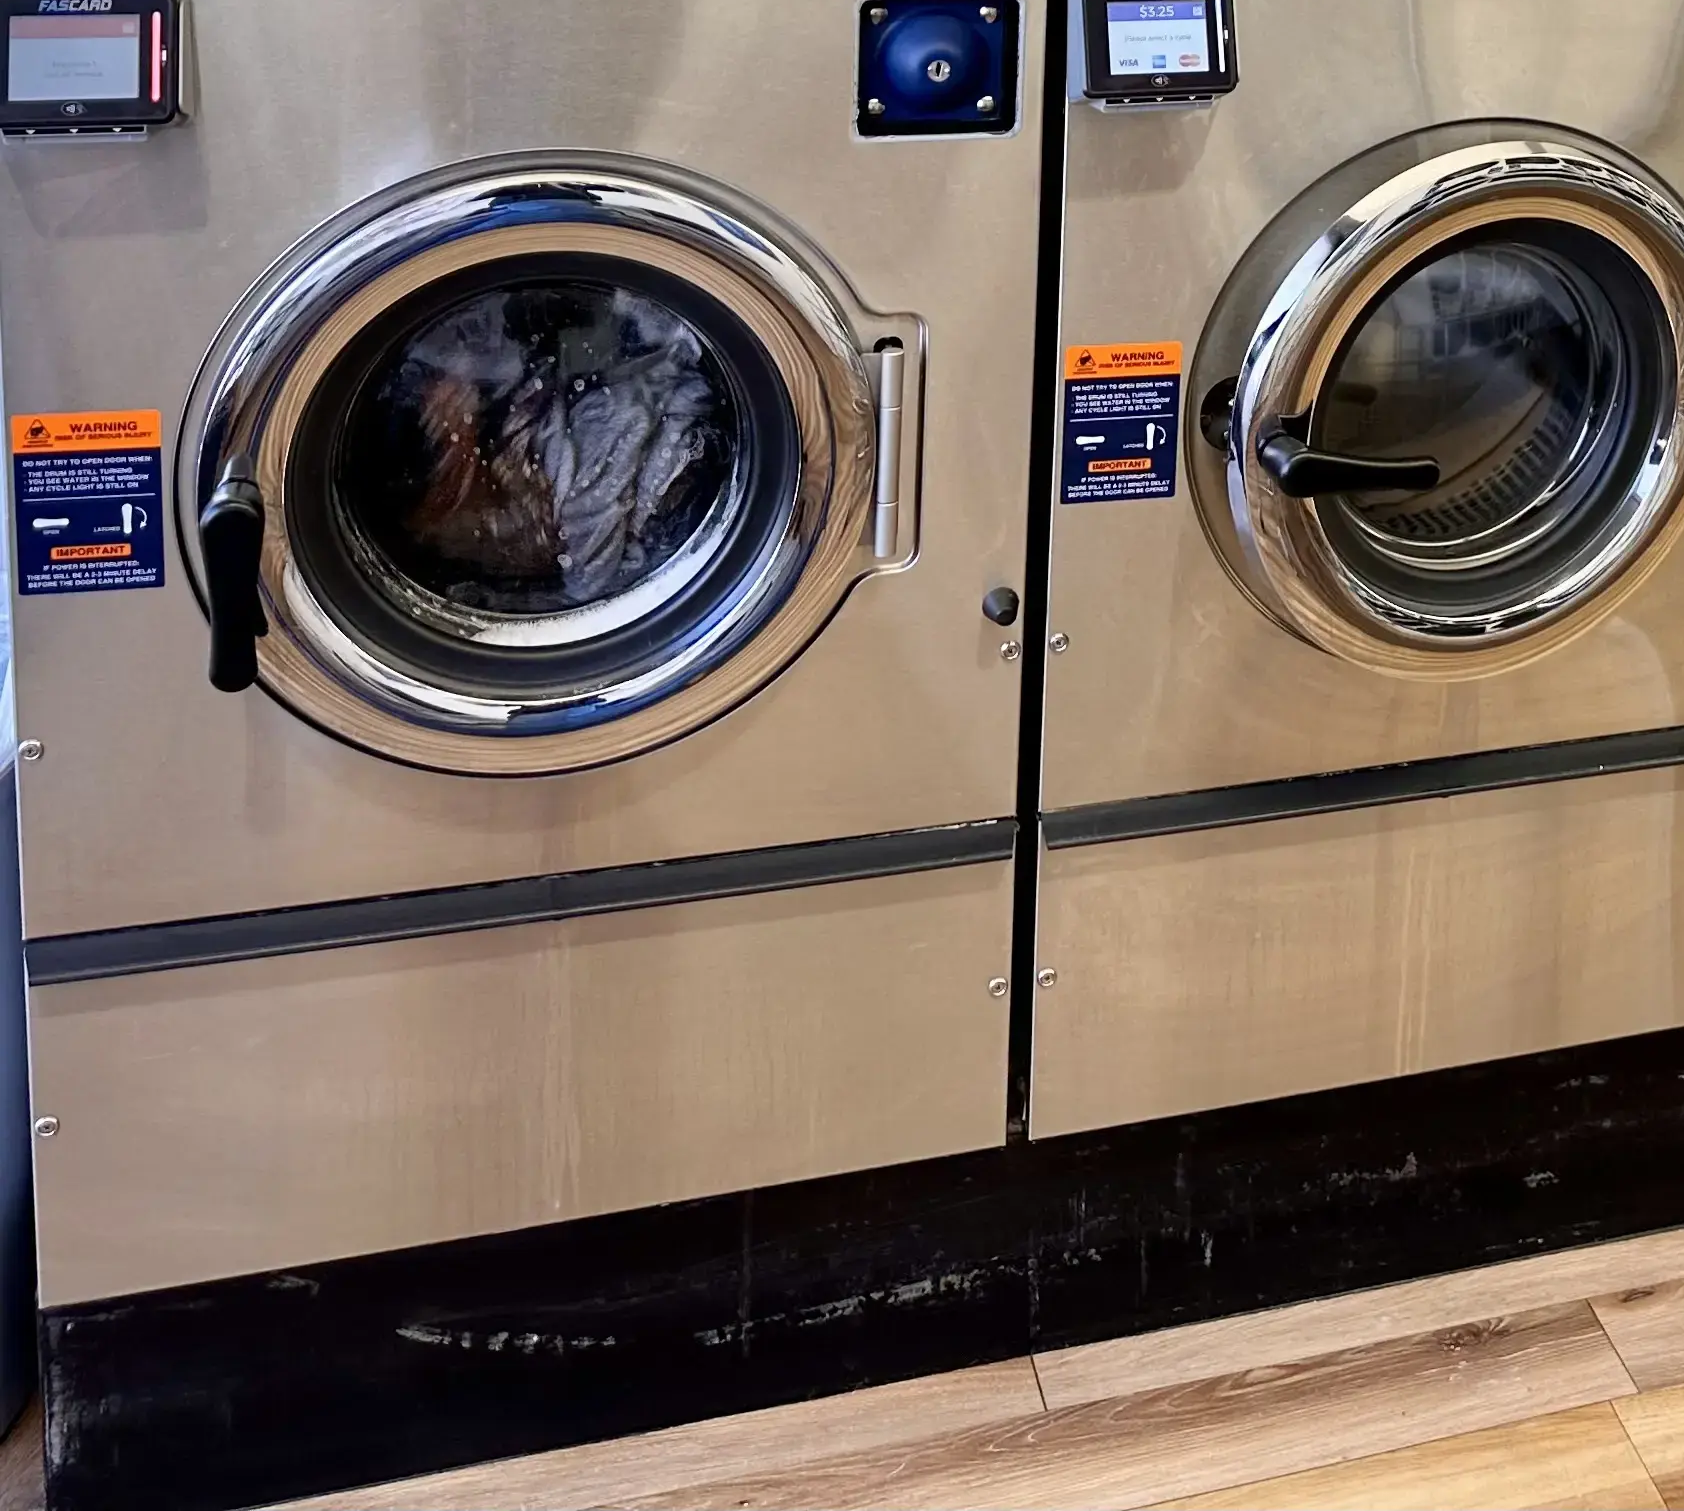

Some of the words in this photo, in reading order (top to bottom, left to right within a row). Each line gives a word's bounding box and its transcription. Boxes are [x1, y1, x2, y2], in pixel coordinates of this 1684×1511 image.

[38, 0, 112, 12] FASCARD
[1139, 5, 1175, 18] $3.25
[1111, 351, 1164, 361] WARNING
[69, 421, 137, 433] WARNING
[1092, 461, 1147, 470] IMPORTANT
[56, 545, 126, 556] IMPORTANT
